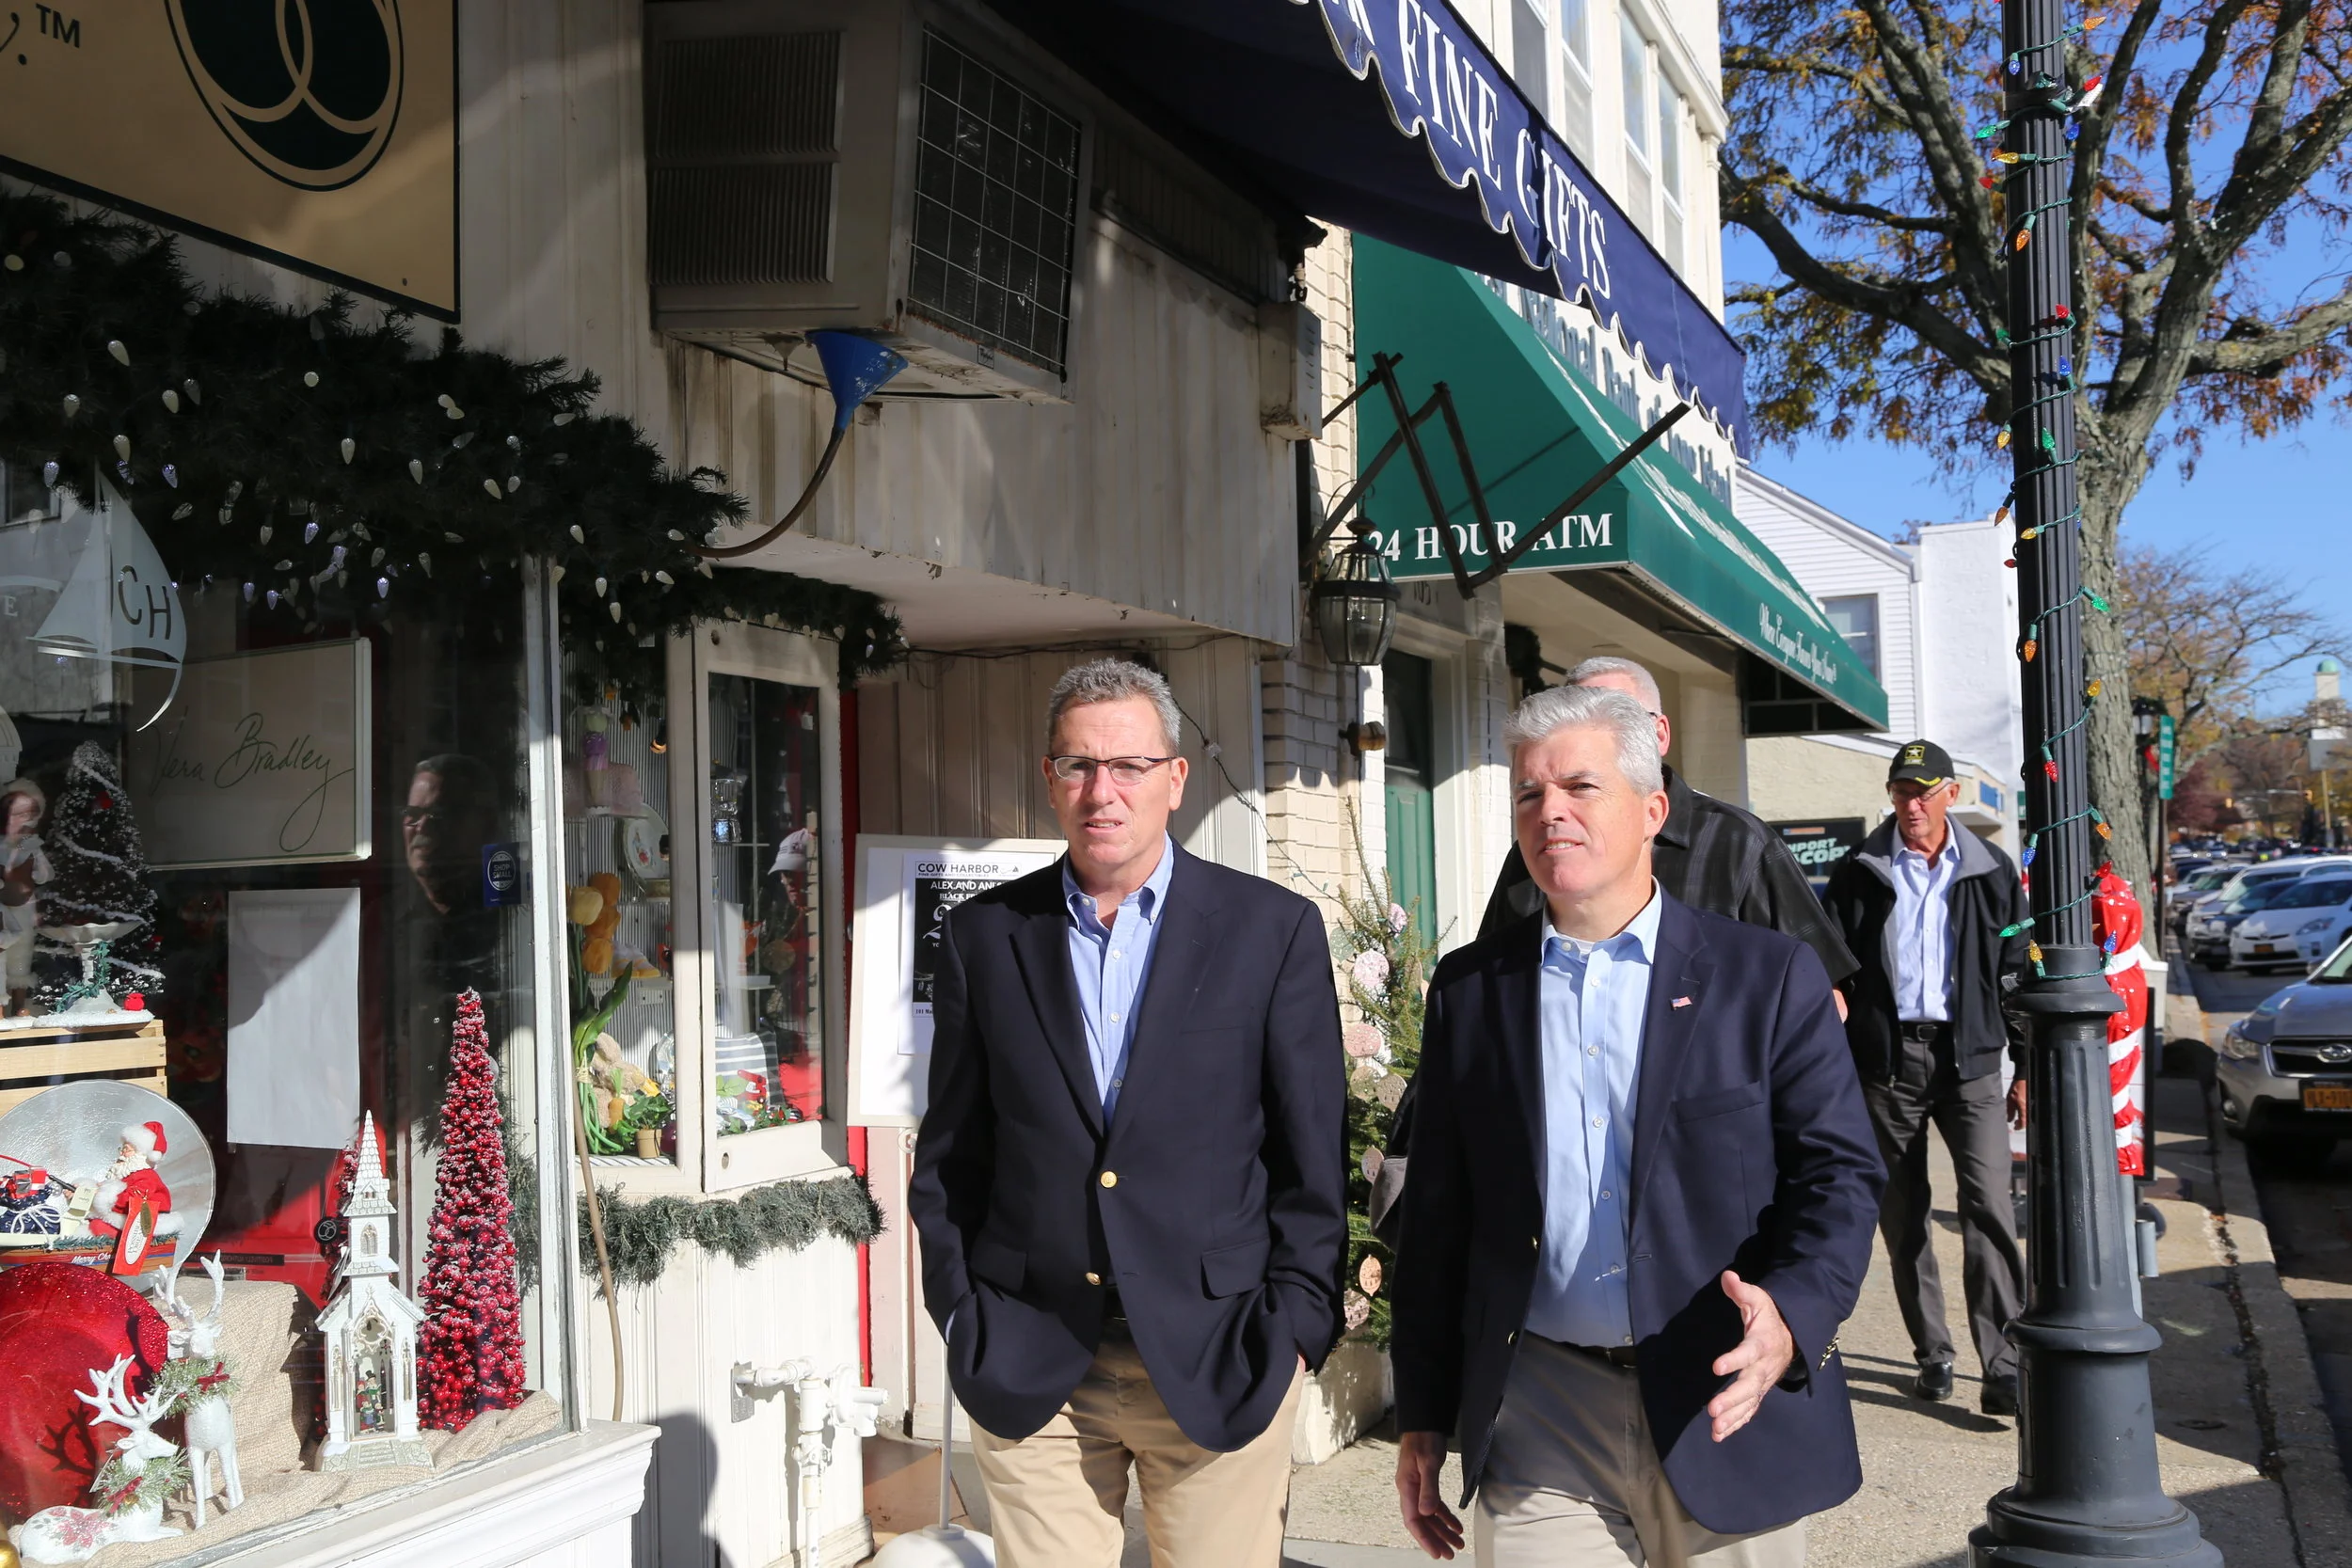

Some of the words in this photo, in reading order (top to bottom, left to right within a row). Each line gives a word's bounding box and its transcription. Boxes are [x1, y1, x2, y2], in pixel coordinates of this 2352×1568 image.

[35, 3, 81, 49] TM
[1398, 0, 1502, 191] FINE
[1515, 128, 1611, 300] GIFTS
[1531, 513, 1613, 552] ATM
[118, 564, 172, 641] CH
[147, 705, 206, 799] Vera
[214, 711, 356, 852] Bradley
[917, 863, 947, 874] COW
[950, 864, 999, 874] HARBOR
